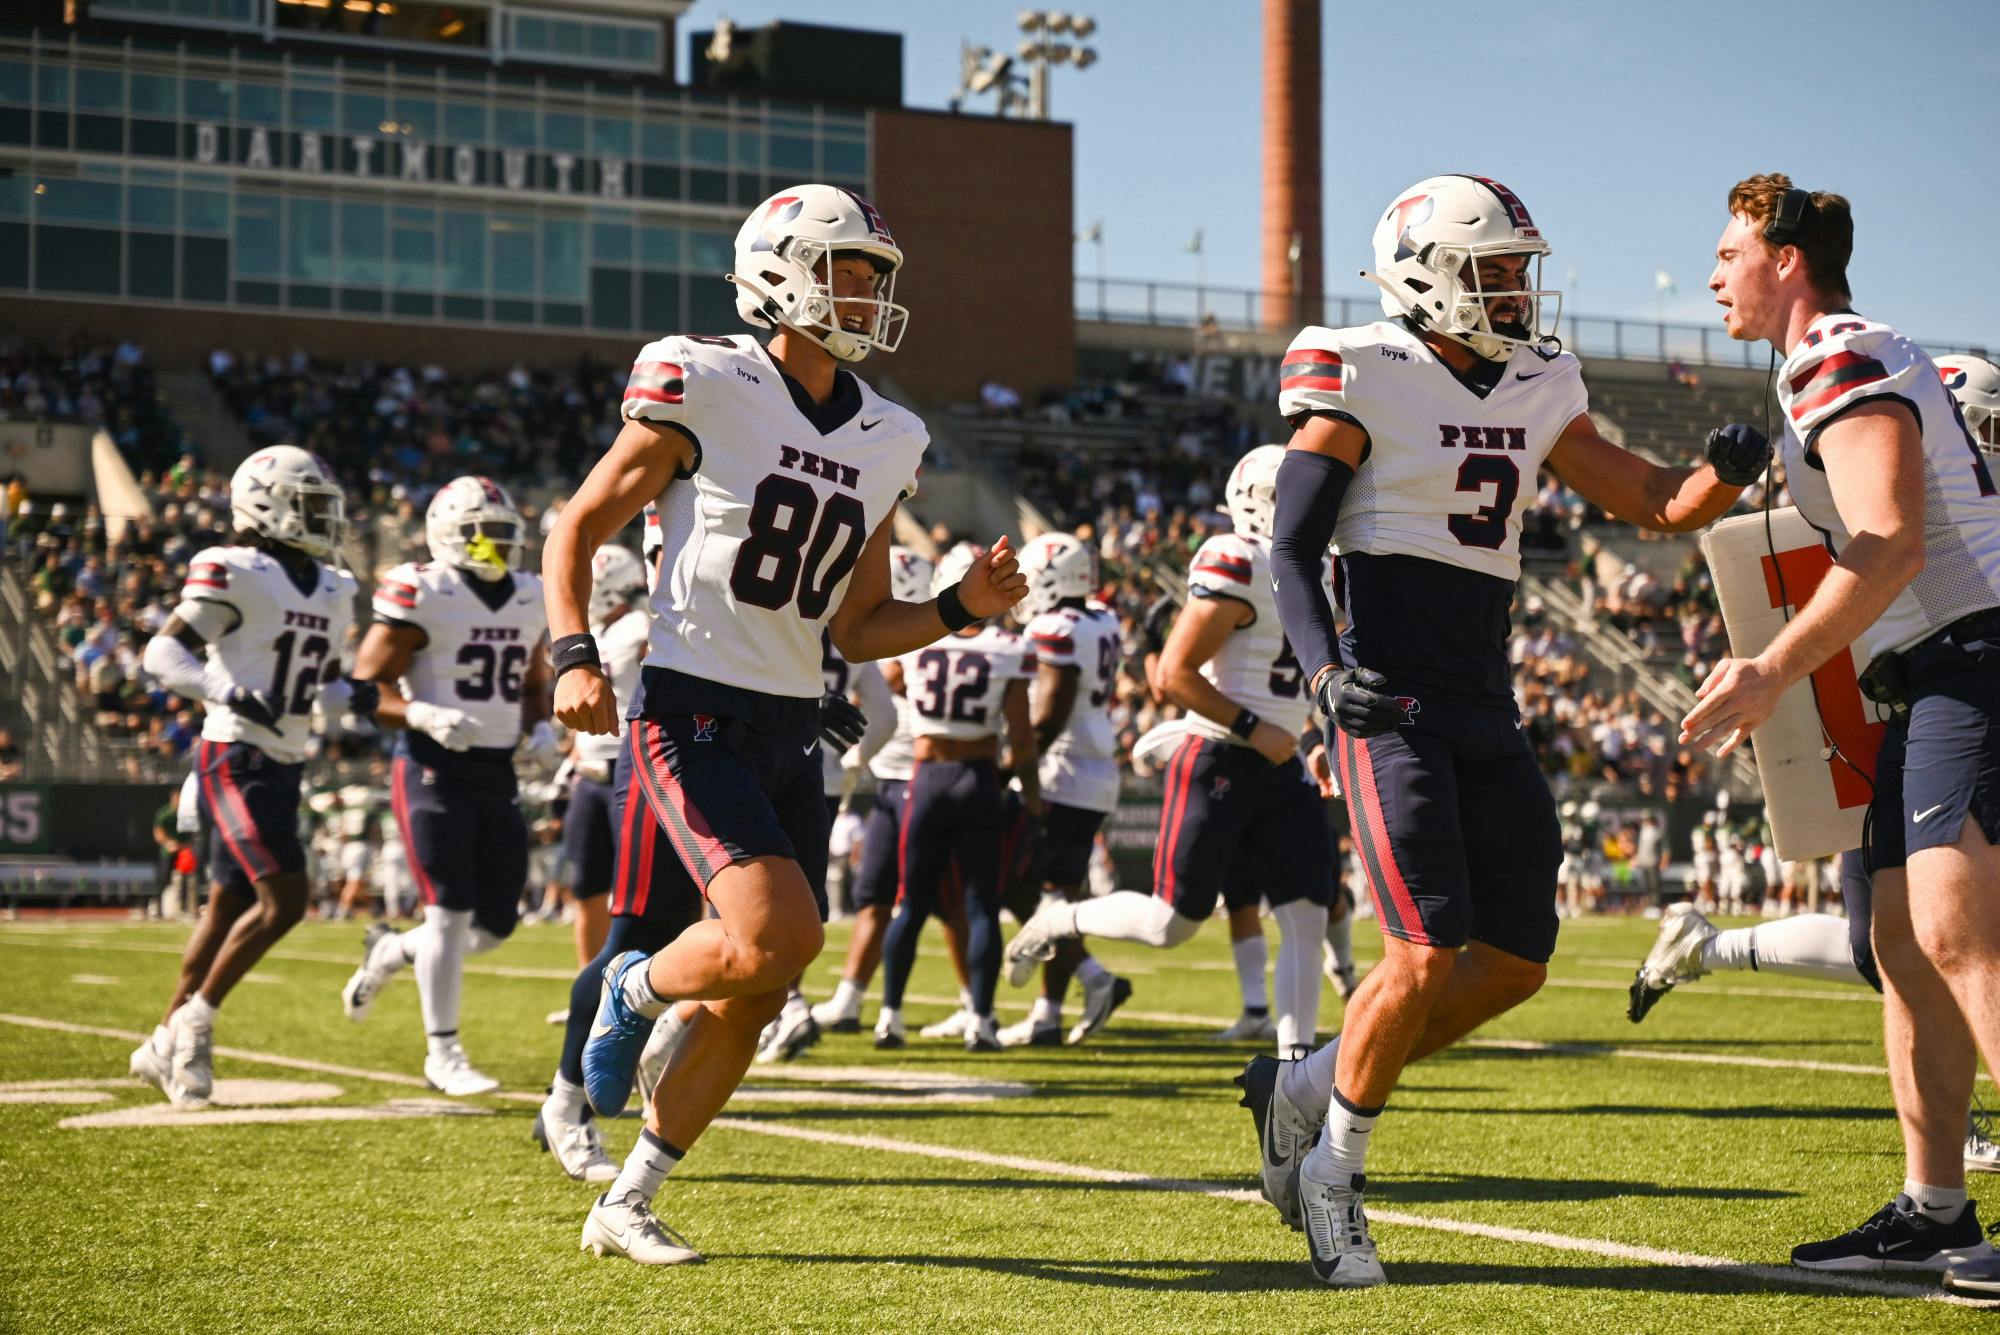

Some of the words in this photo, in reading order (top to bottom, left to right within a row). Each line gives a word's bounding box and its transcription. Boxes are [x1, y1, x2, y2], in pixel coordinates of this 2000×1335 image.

[195, 121, 628, 199] DARTMOUTH
[736, 367, 753, 382] Ivy
[1381, 346, 1399, 361] Ivy
[1439, 424, 1526, 450] PENN
[779, 445, 860, 490] PENN
[1447, 453, 1520, 551] 3
[729, 473, 866, 620] 80
[283, 610, 331, 632] PENN
[470, 627, 521, 641] PENN
[272, 630, 331, 714] 12
[454, 643, 528, 704] 36
[915, 648, 992, 724] 32
